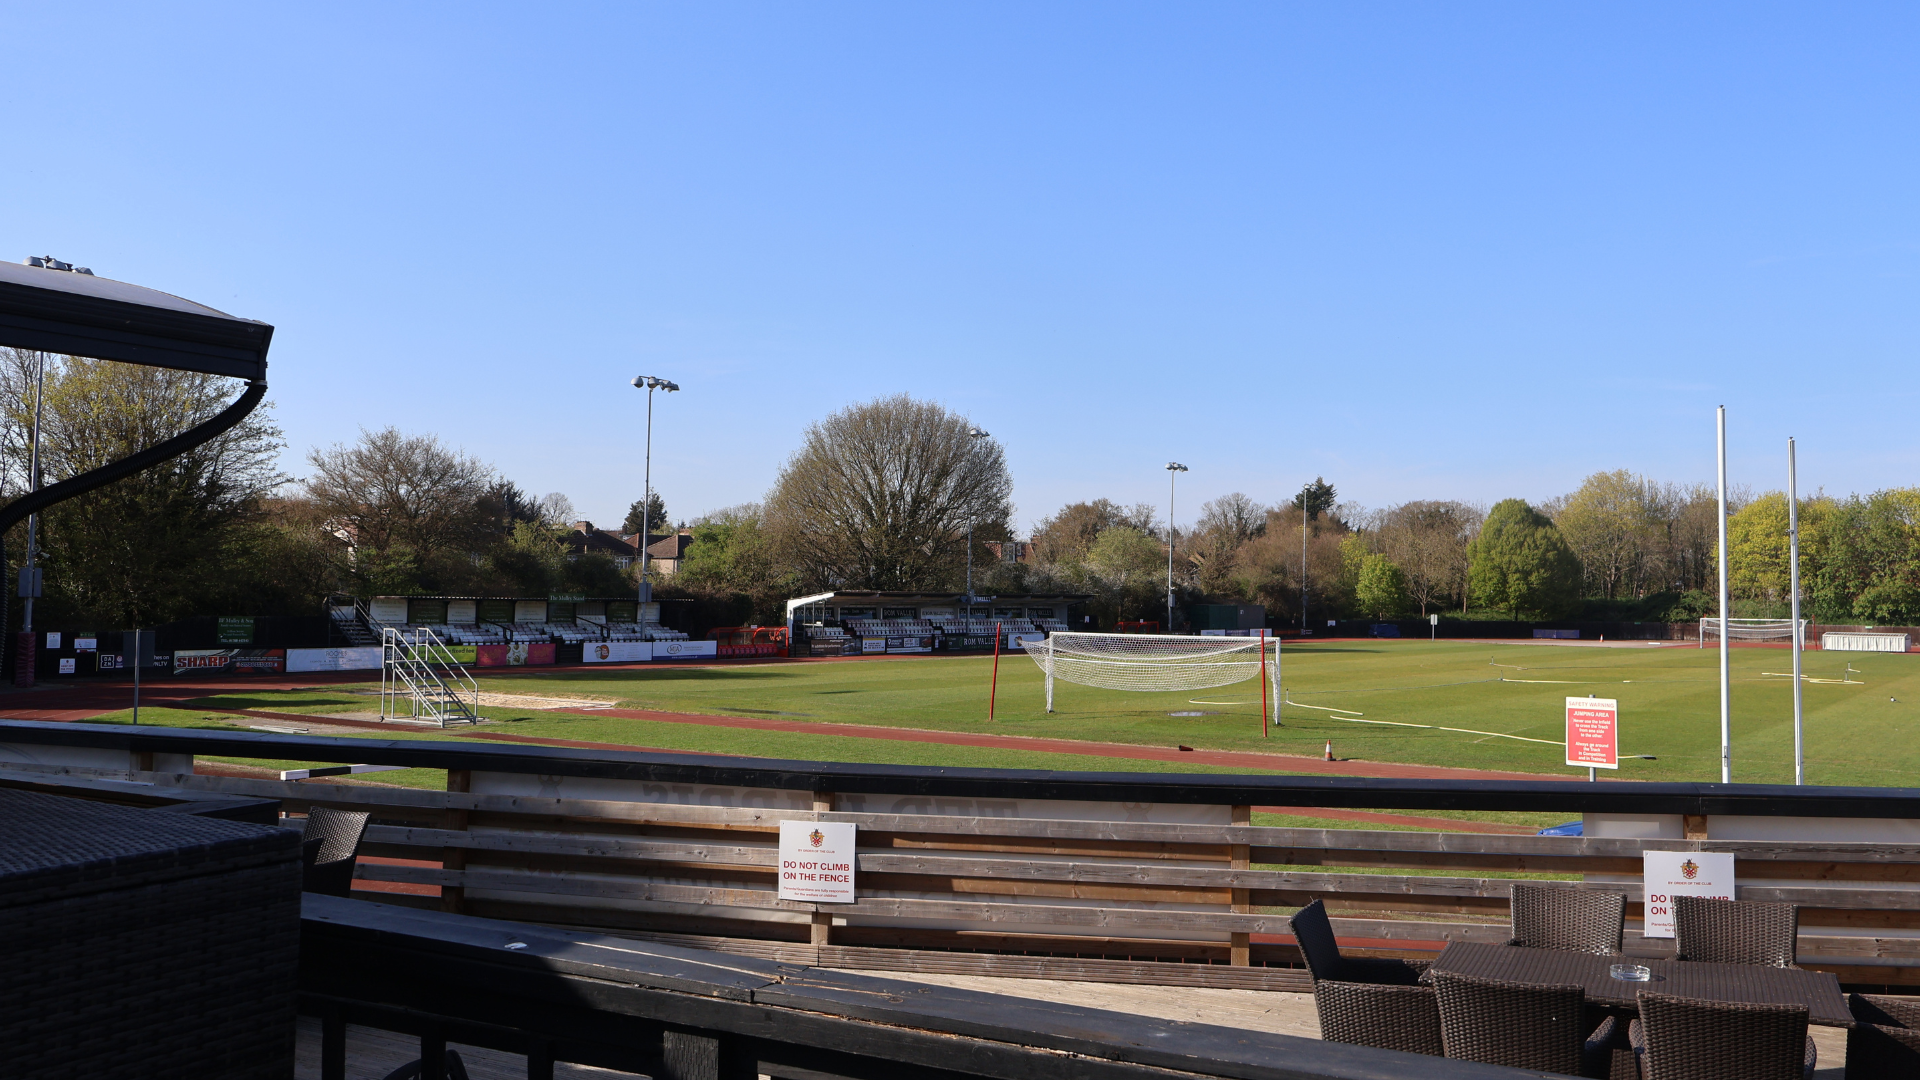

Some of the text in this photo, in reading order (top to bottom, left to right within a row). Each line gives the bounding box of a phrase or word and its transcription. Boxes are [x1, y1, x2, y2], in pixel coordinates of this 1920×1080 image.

[176, 655, 229, 668] SHARP
[820, 863, 850, 871] CLIMB
[799, 873, 816, 881] THE
[819, 874, 850, 882] FENCE
